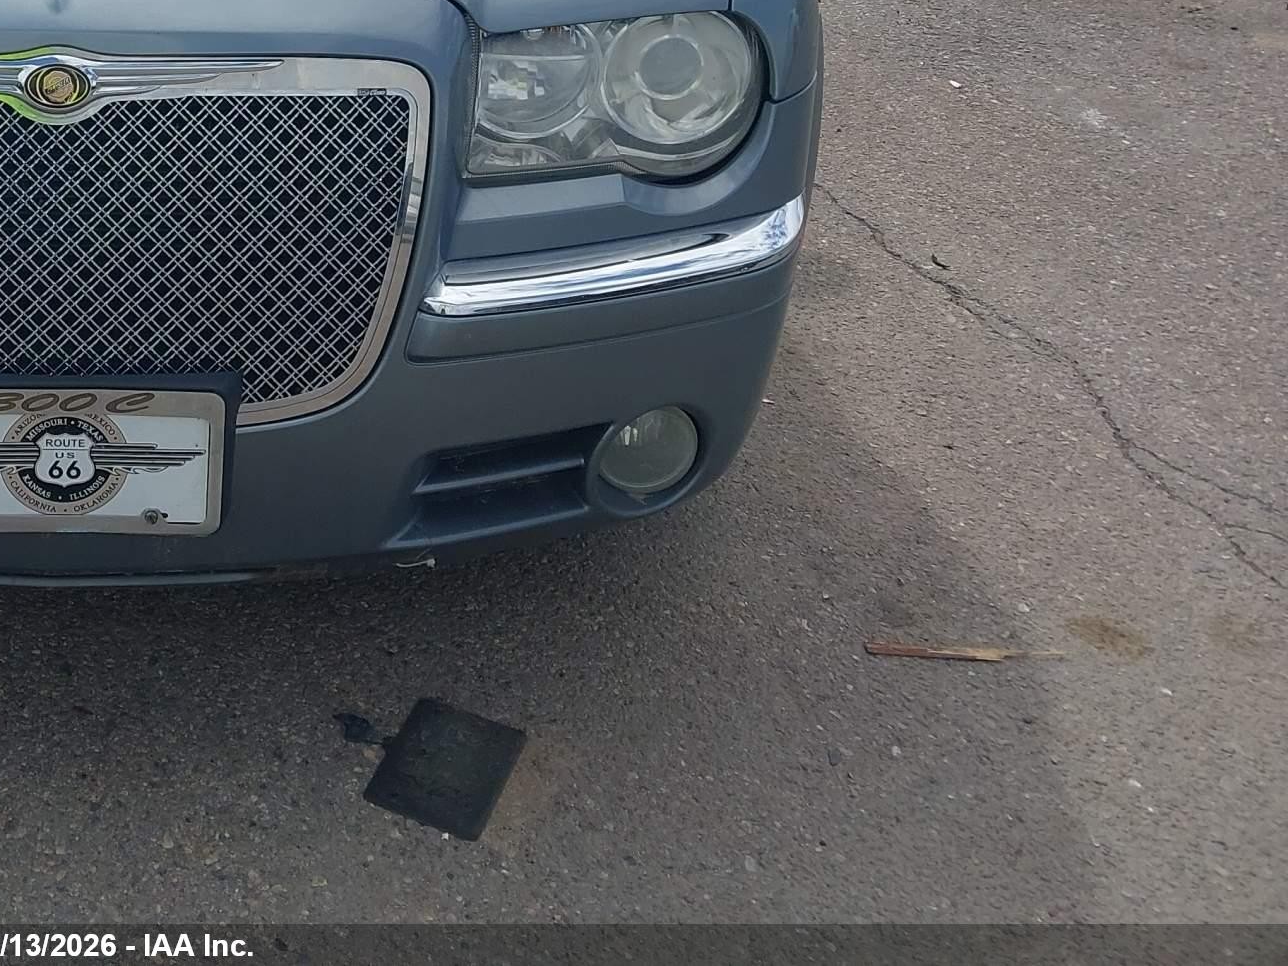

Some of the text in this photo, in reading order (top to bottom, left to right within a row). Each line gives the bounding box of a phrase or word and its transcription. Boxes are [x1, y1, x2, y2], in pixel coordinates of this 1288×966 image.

[14, 413, 45, 436] ARIZON
[25, 417, 104, 442] MISSOURI TEXAS
[45, 438, 86, 448] ROUTE
[48, 460, 81, 480] 66
[10, 480, 119, 513] CALIFORNIA OKLAHOMA
[22, 474, 106, 501] KANSAS ILLINOIS
